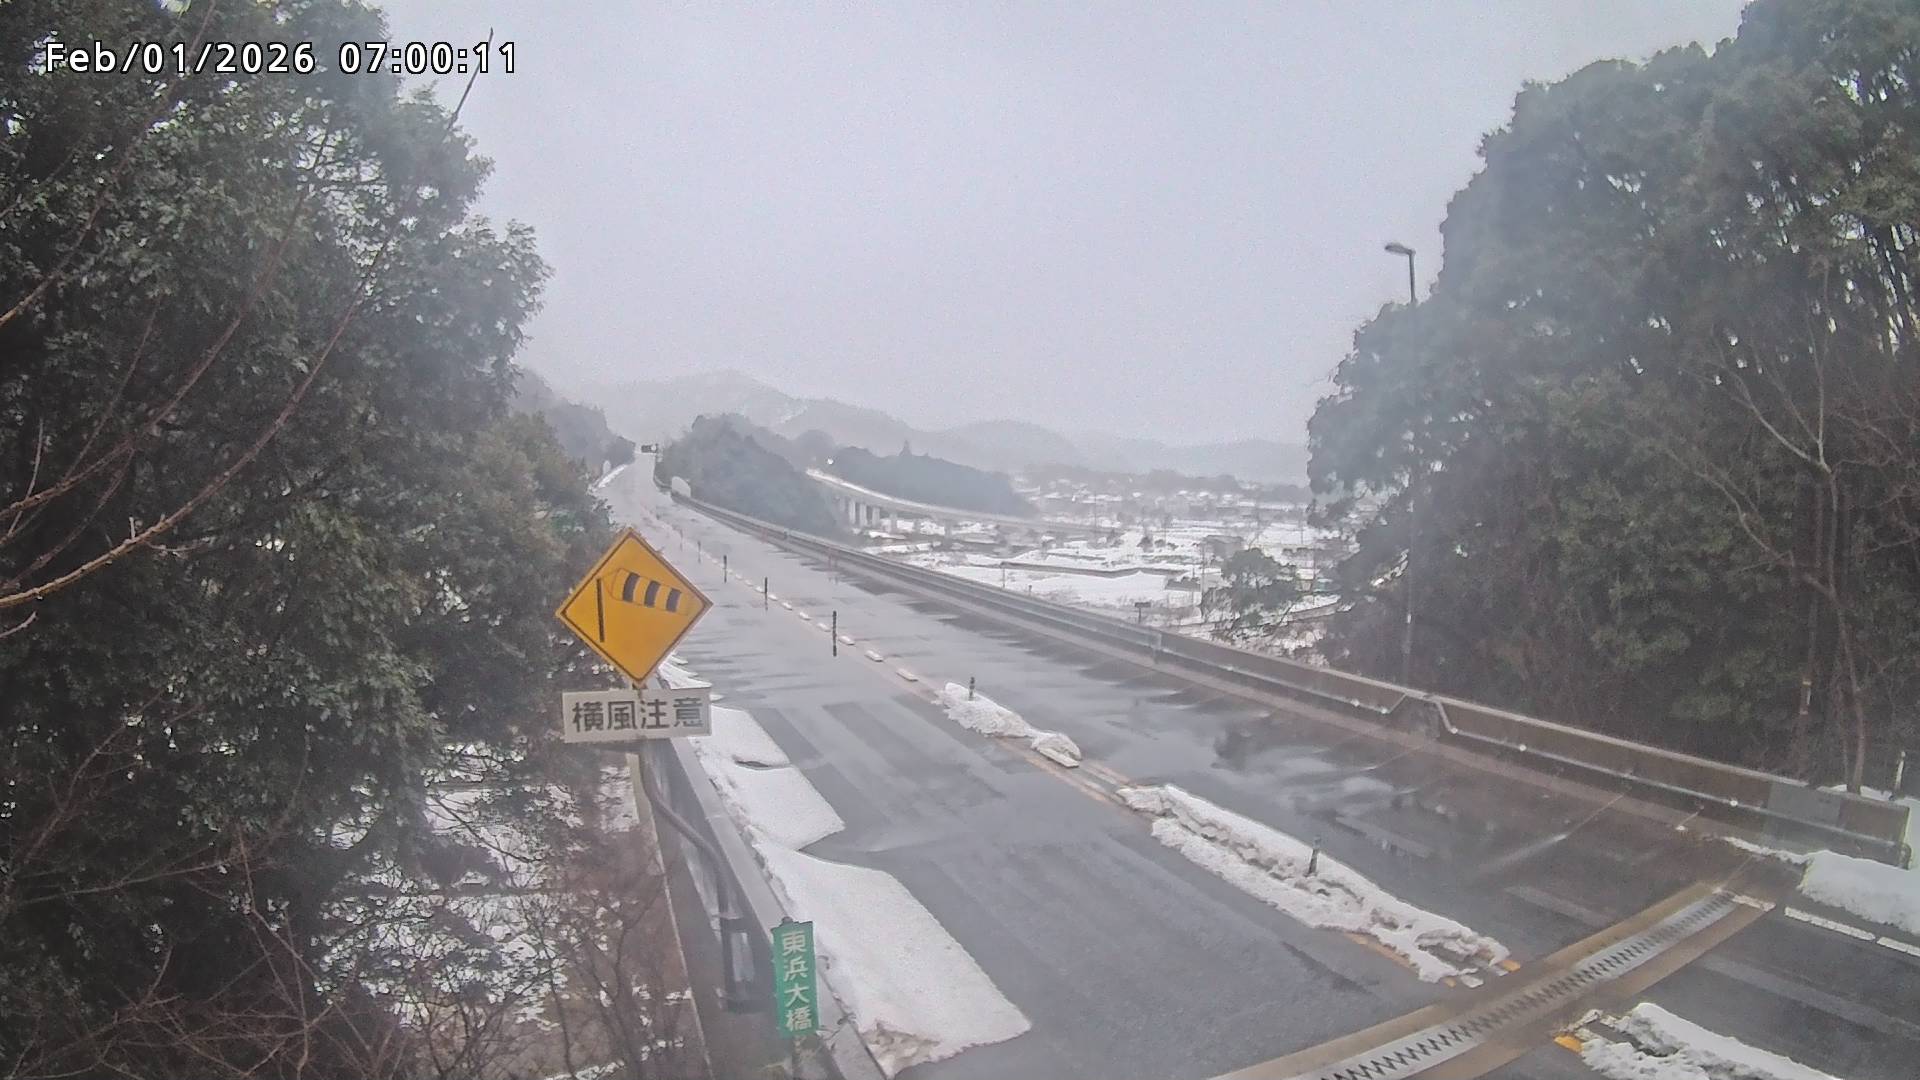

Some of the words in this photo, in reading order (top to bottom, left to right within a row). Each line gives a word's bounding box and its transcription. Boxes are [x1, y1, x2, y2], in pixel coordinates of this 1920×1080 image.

[572, 698, 704, 732] 横風注意
[782, 930, 812, 1032] 東浜大橋
